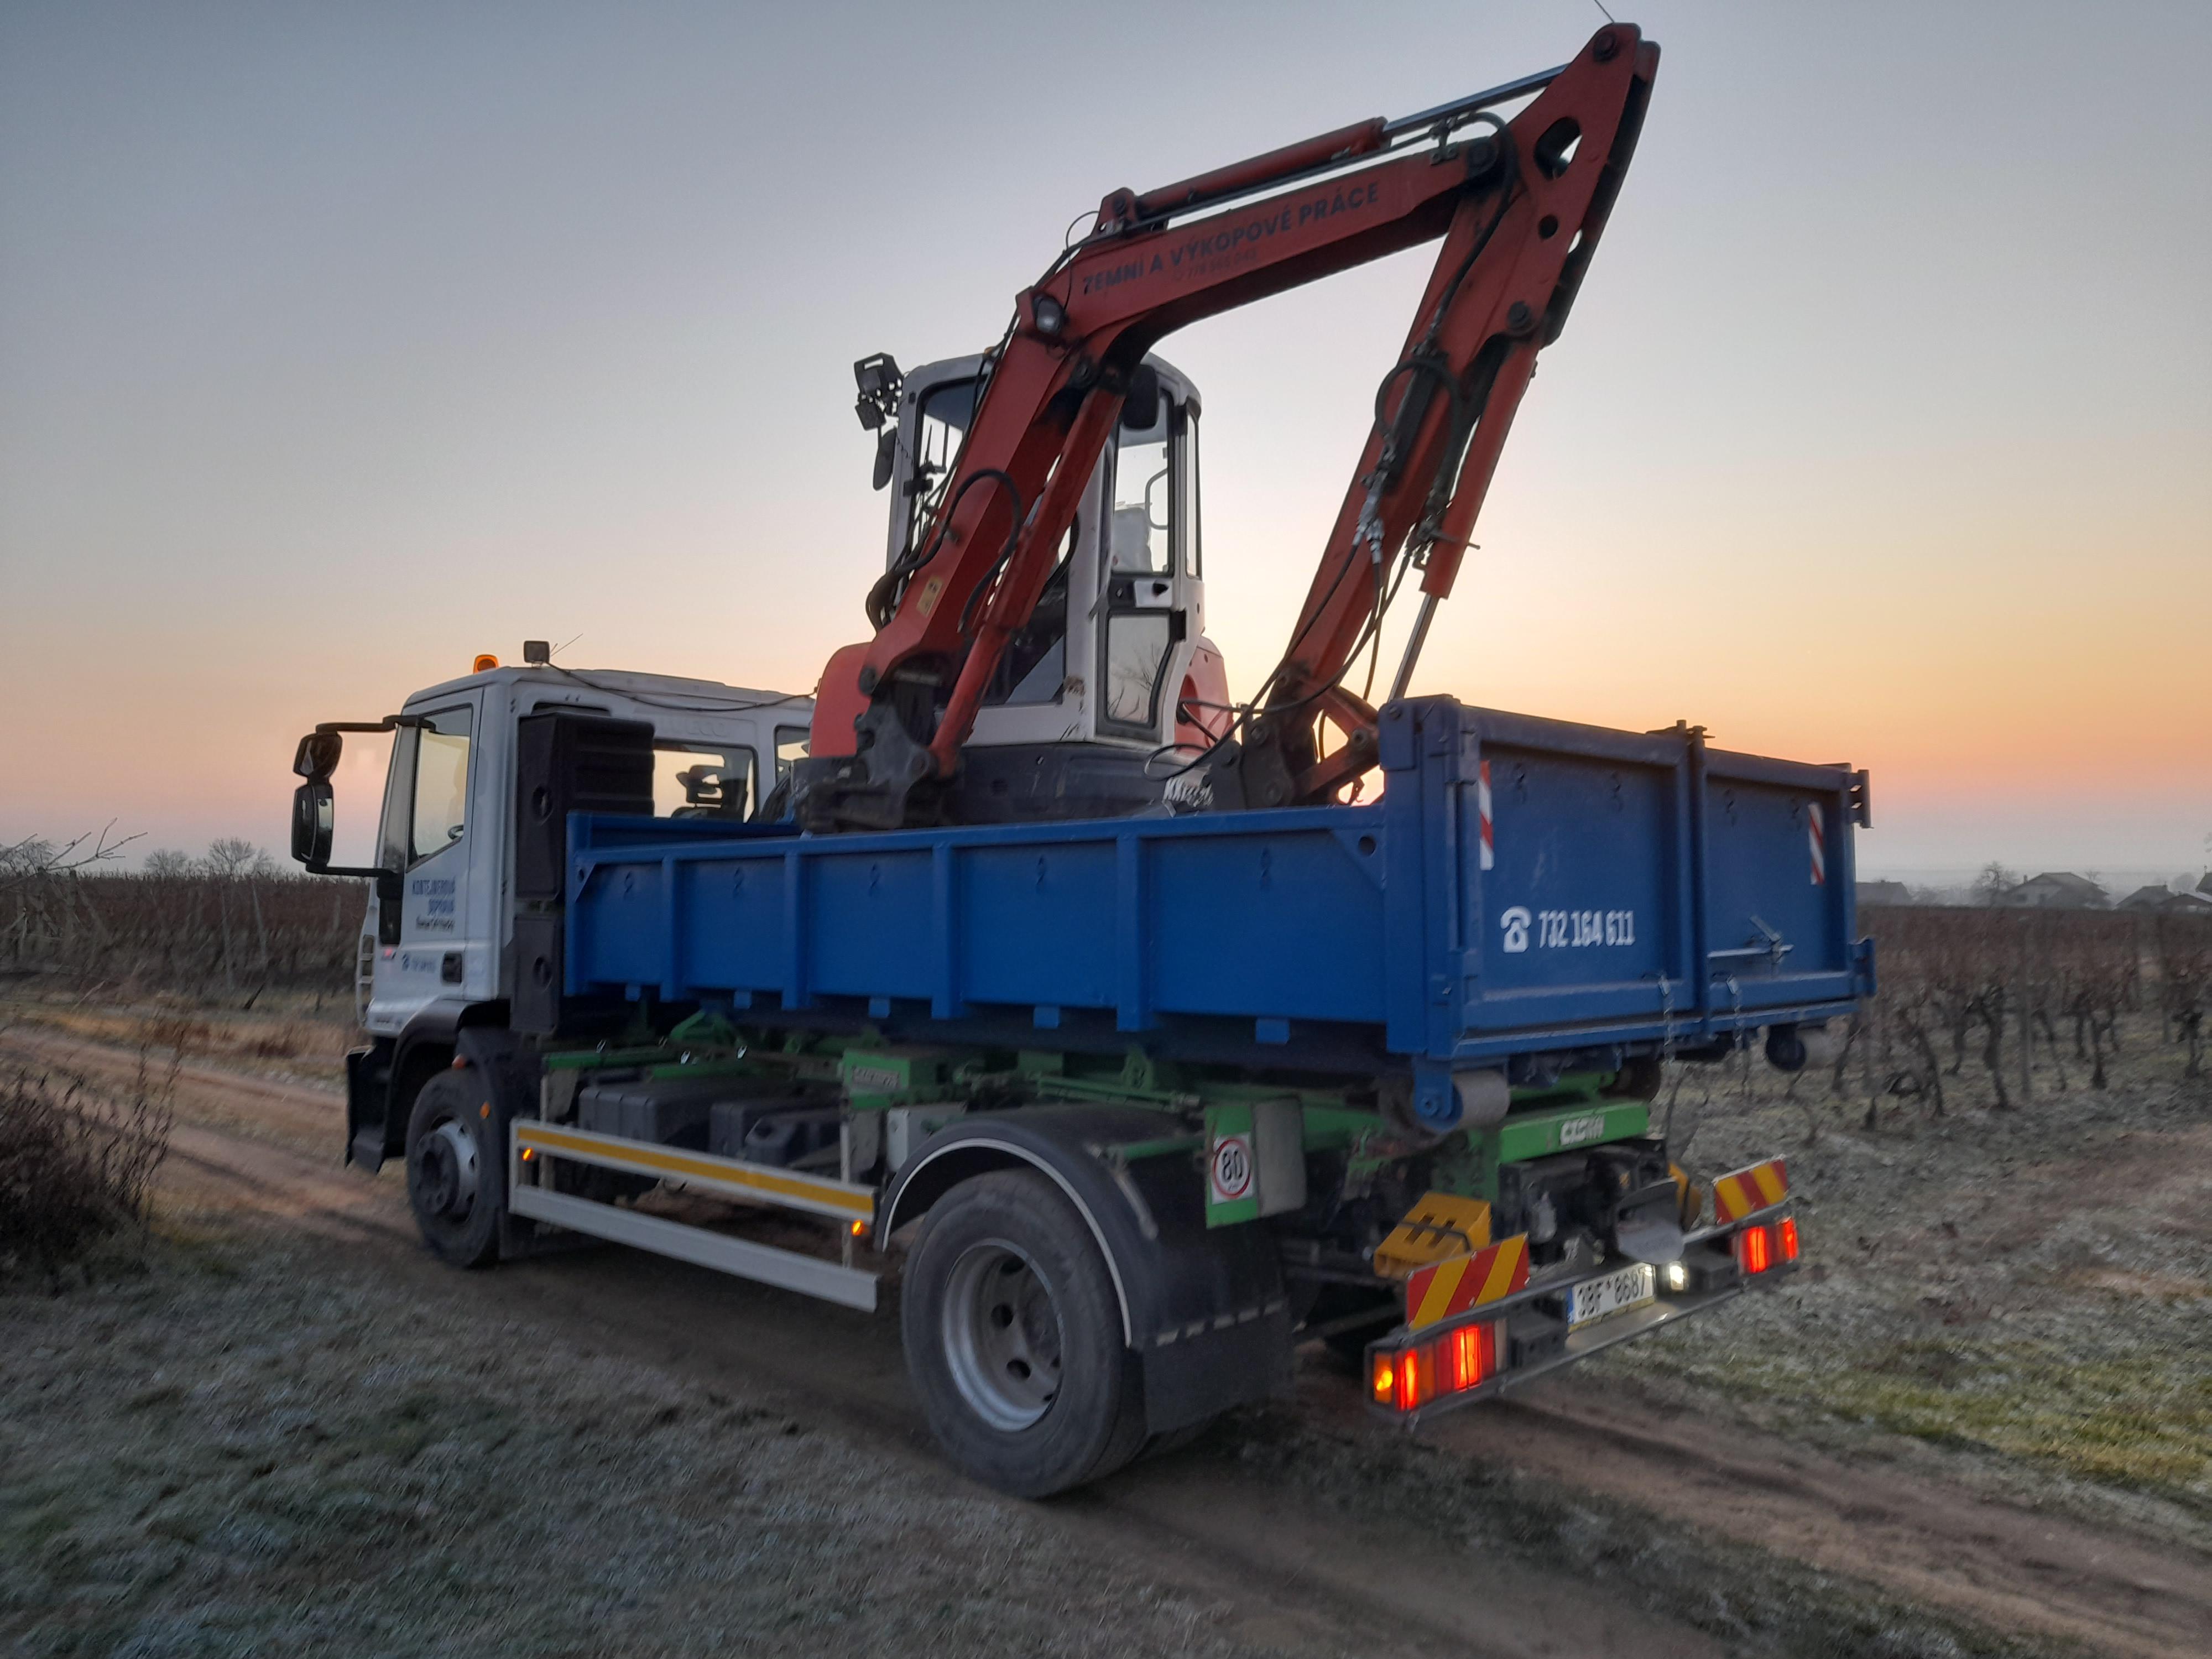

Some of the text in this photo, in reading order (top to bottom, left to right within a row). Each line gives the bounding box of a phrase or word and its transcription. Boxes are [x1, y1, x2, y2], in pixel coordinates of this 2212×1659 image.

[1083, 181, 1379, 295] ZEMNÍ A VÝKOPOVÉ PRÁCE
[1571, 910, 1603, 947] 164
[1605, 910, 1636, 946] 611
[1222, 1149, 1243, 1181] 80
